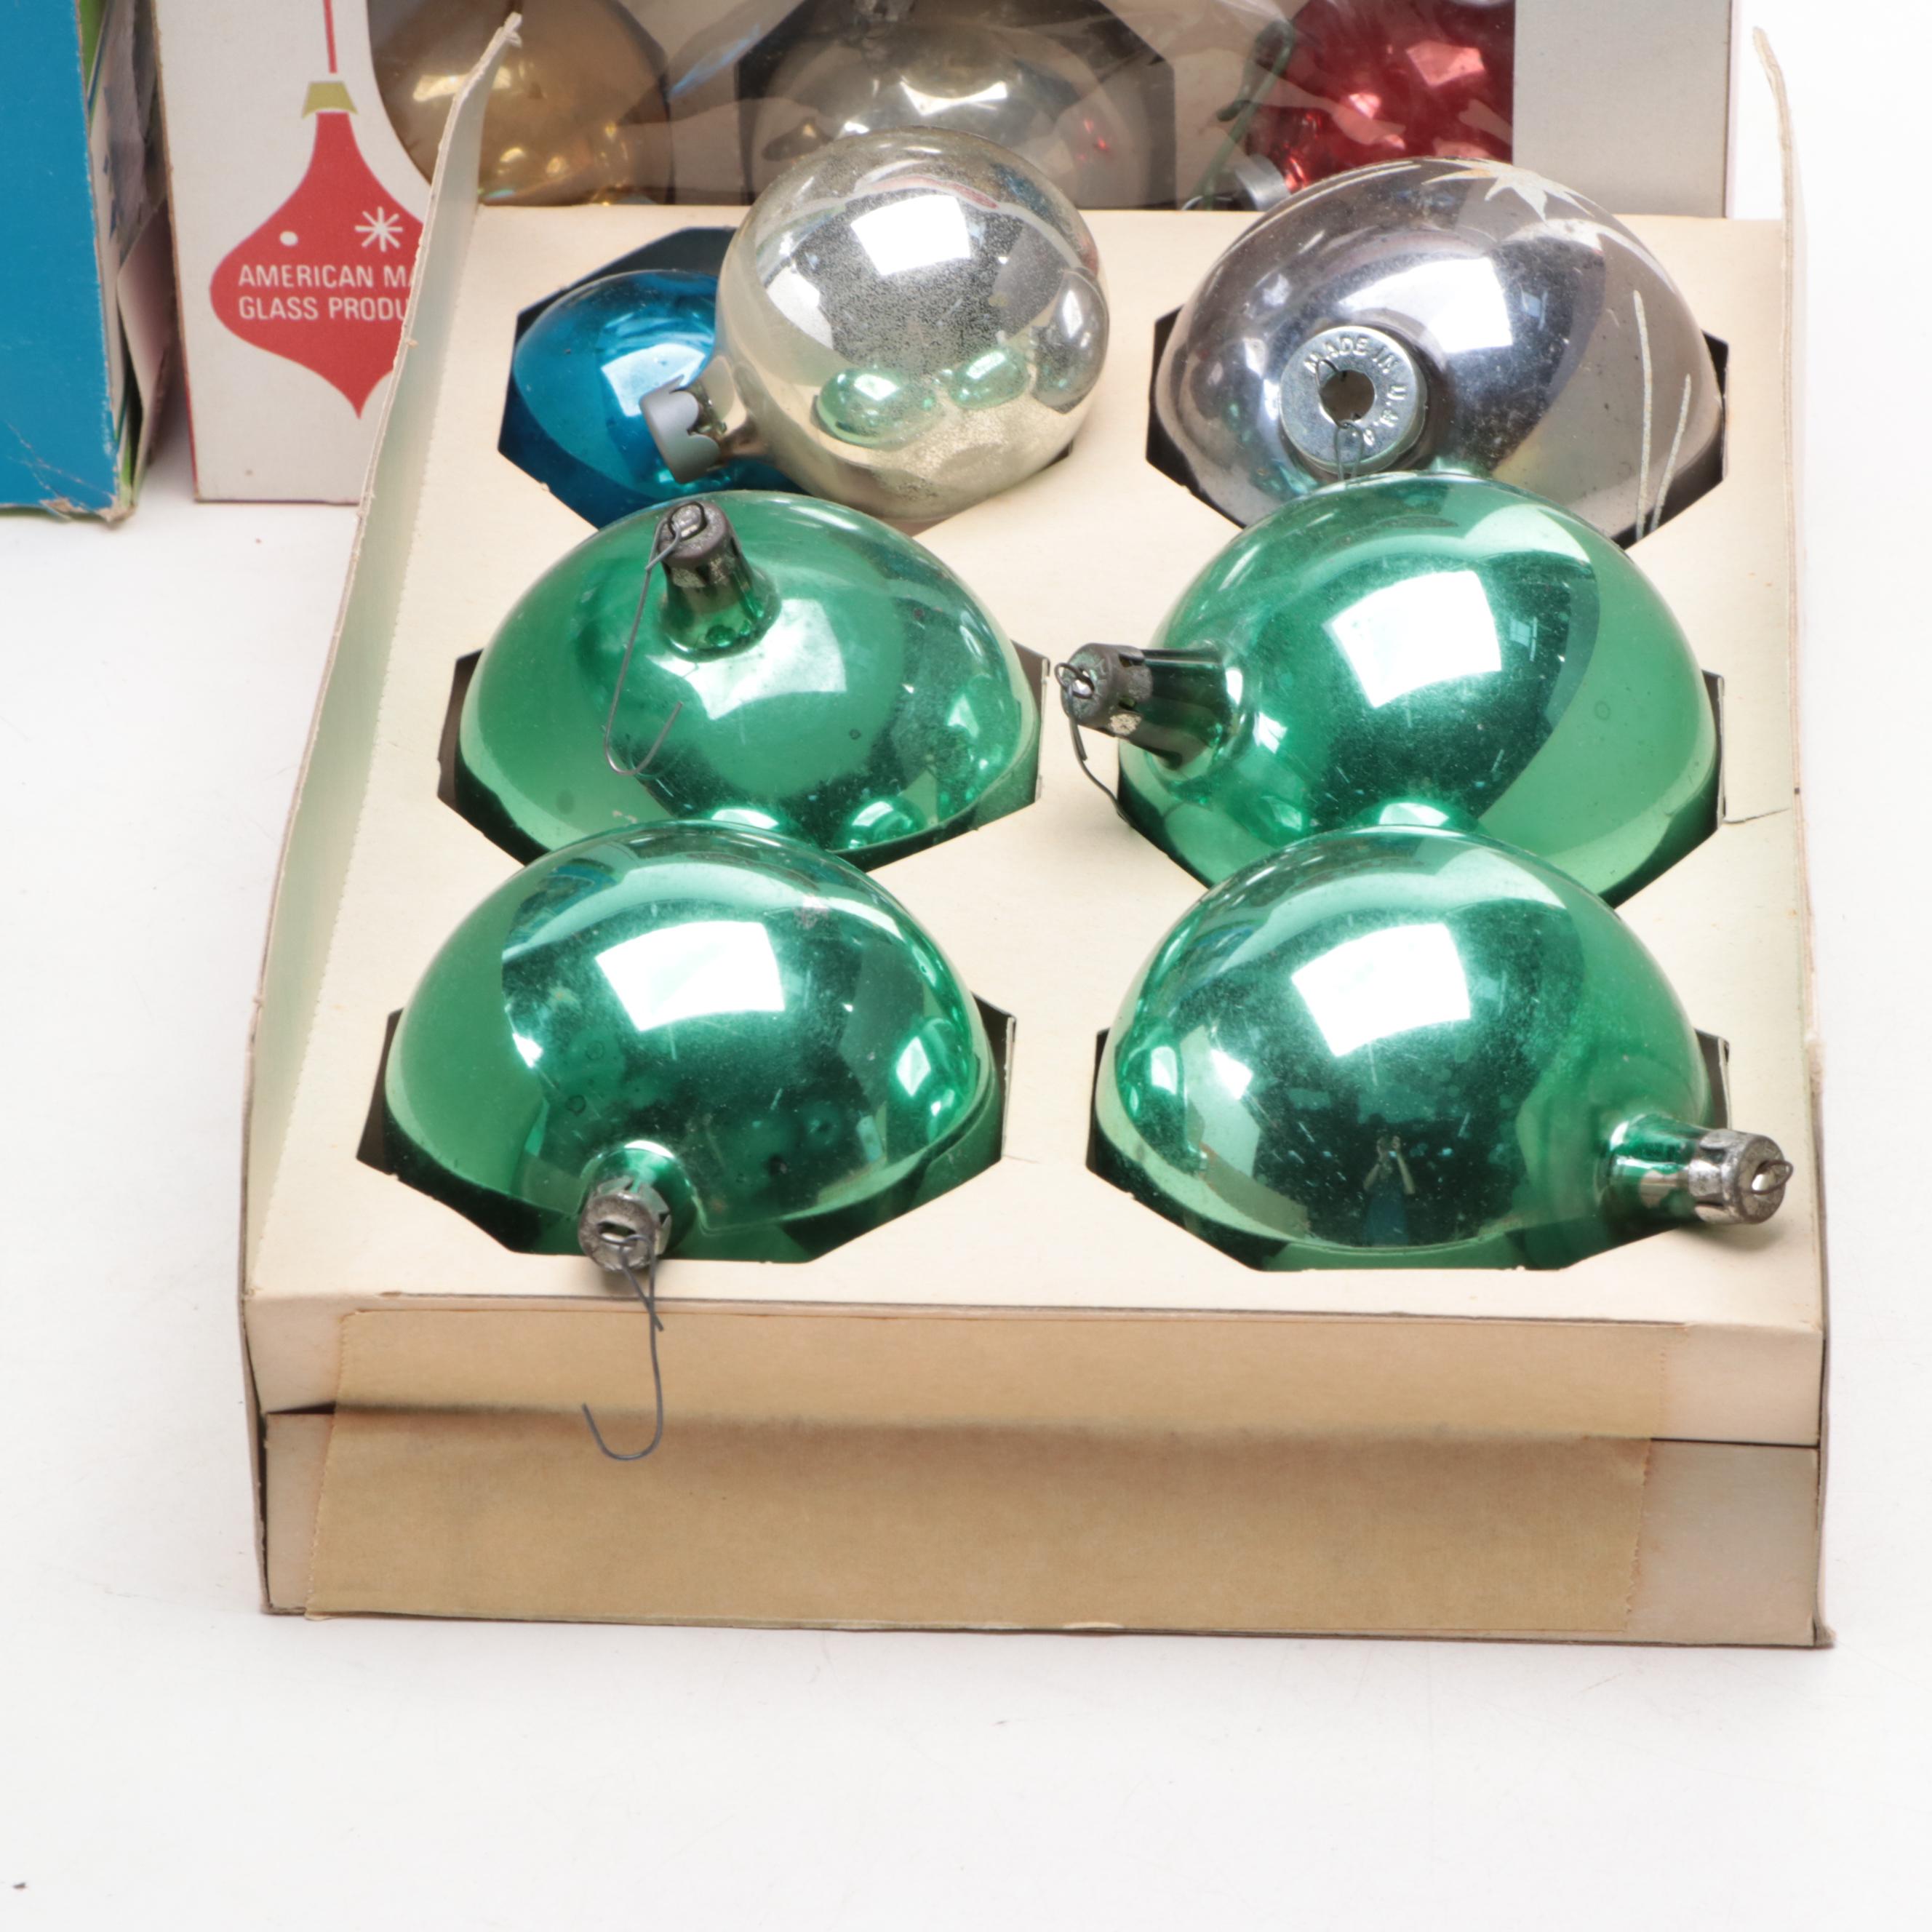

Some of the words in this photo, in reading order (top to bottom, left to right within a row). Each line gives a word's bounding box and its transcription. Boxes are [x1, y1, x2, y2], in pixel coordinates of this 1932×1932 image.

[238, 265, 372, 288] AMERICAN
[239, 296, 319, 320] GLASS
[1304, 336, 1369, 375] MADE
[1372, 345, 1399, 374] IN
